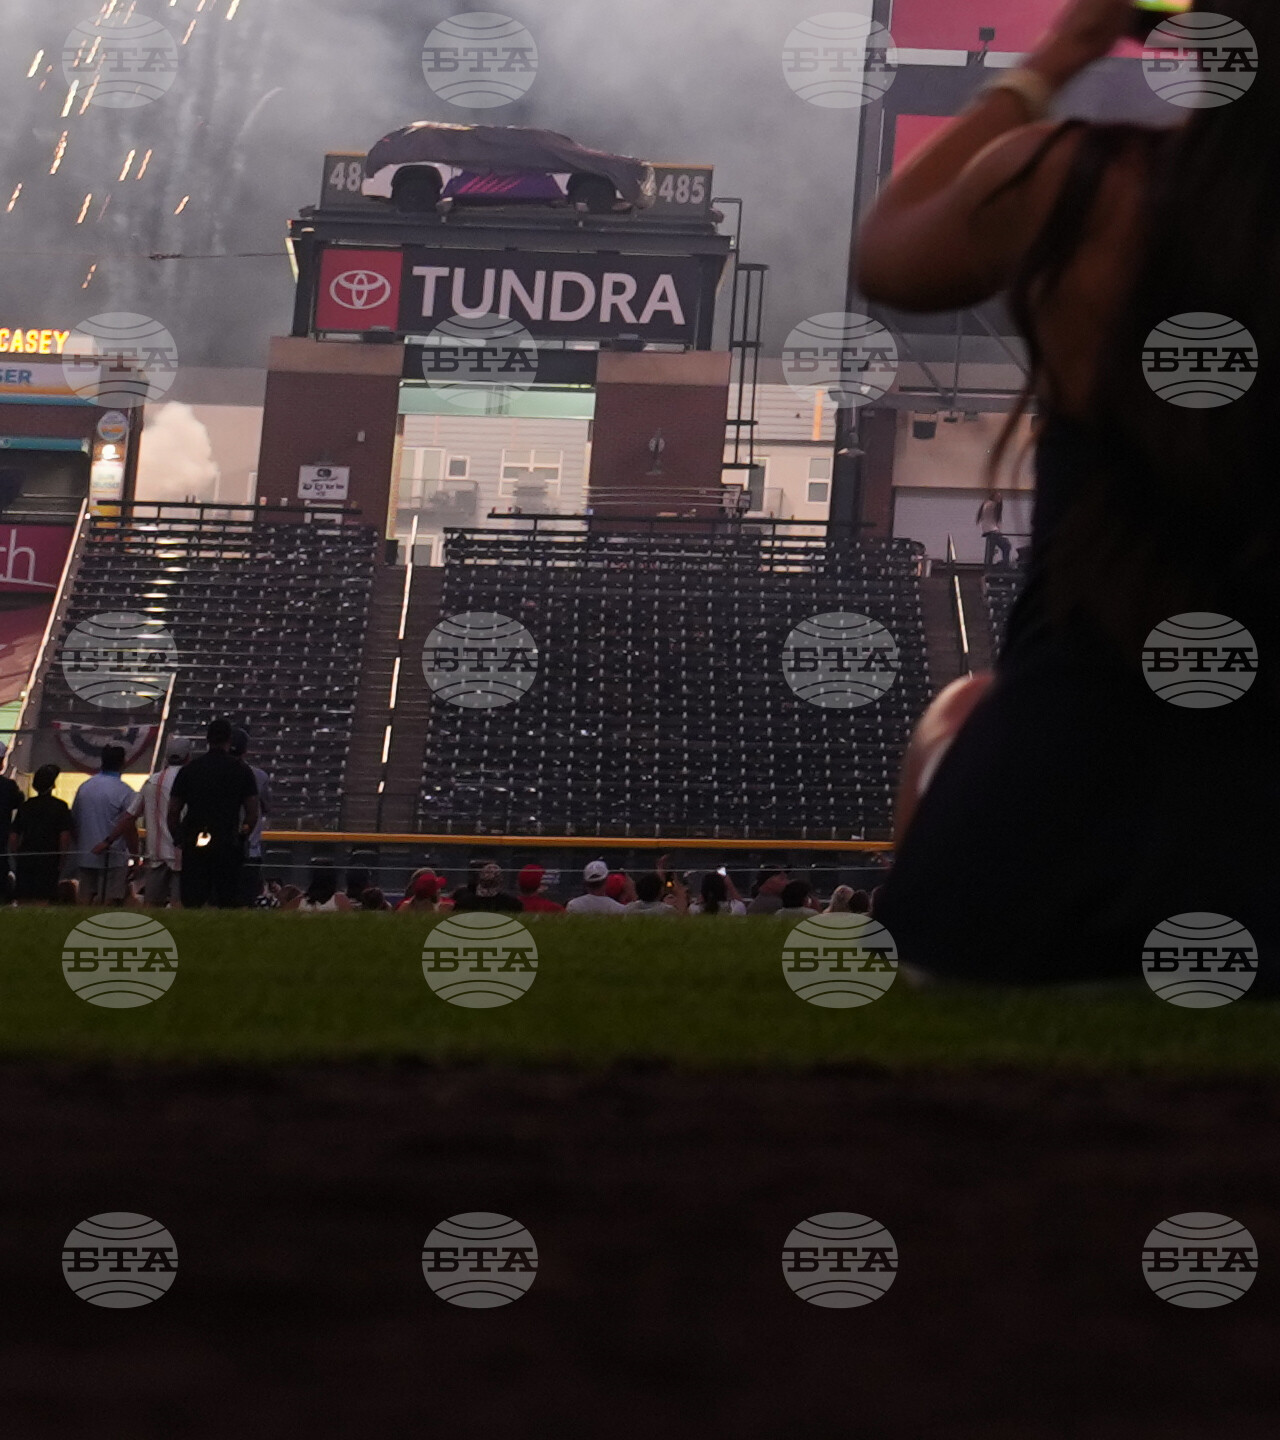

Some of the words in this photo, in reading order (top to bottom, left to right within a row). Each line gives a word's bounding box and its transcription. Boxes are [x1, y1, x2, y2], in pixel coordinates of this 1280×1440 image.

[330, 162, 363, 191] 48
[659, 174, 704, 204] 485
[412, 266, 686, 325] TUNDRA
